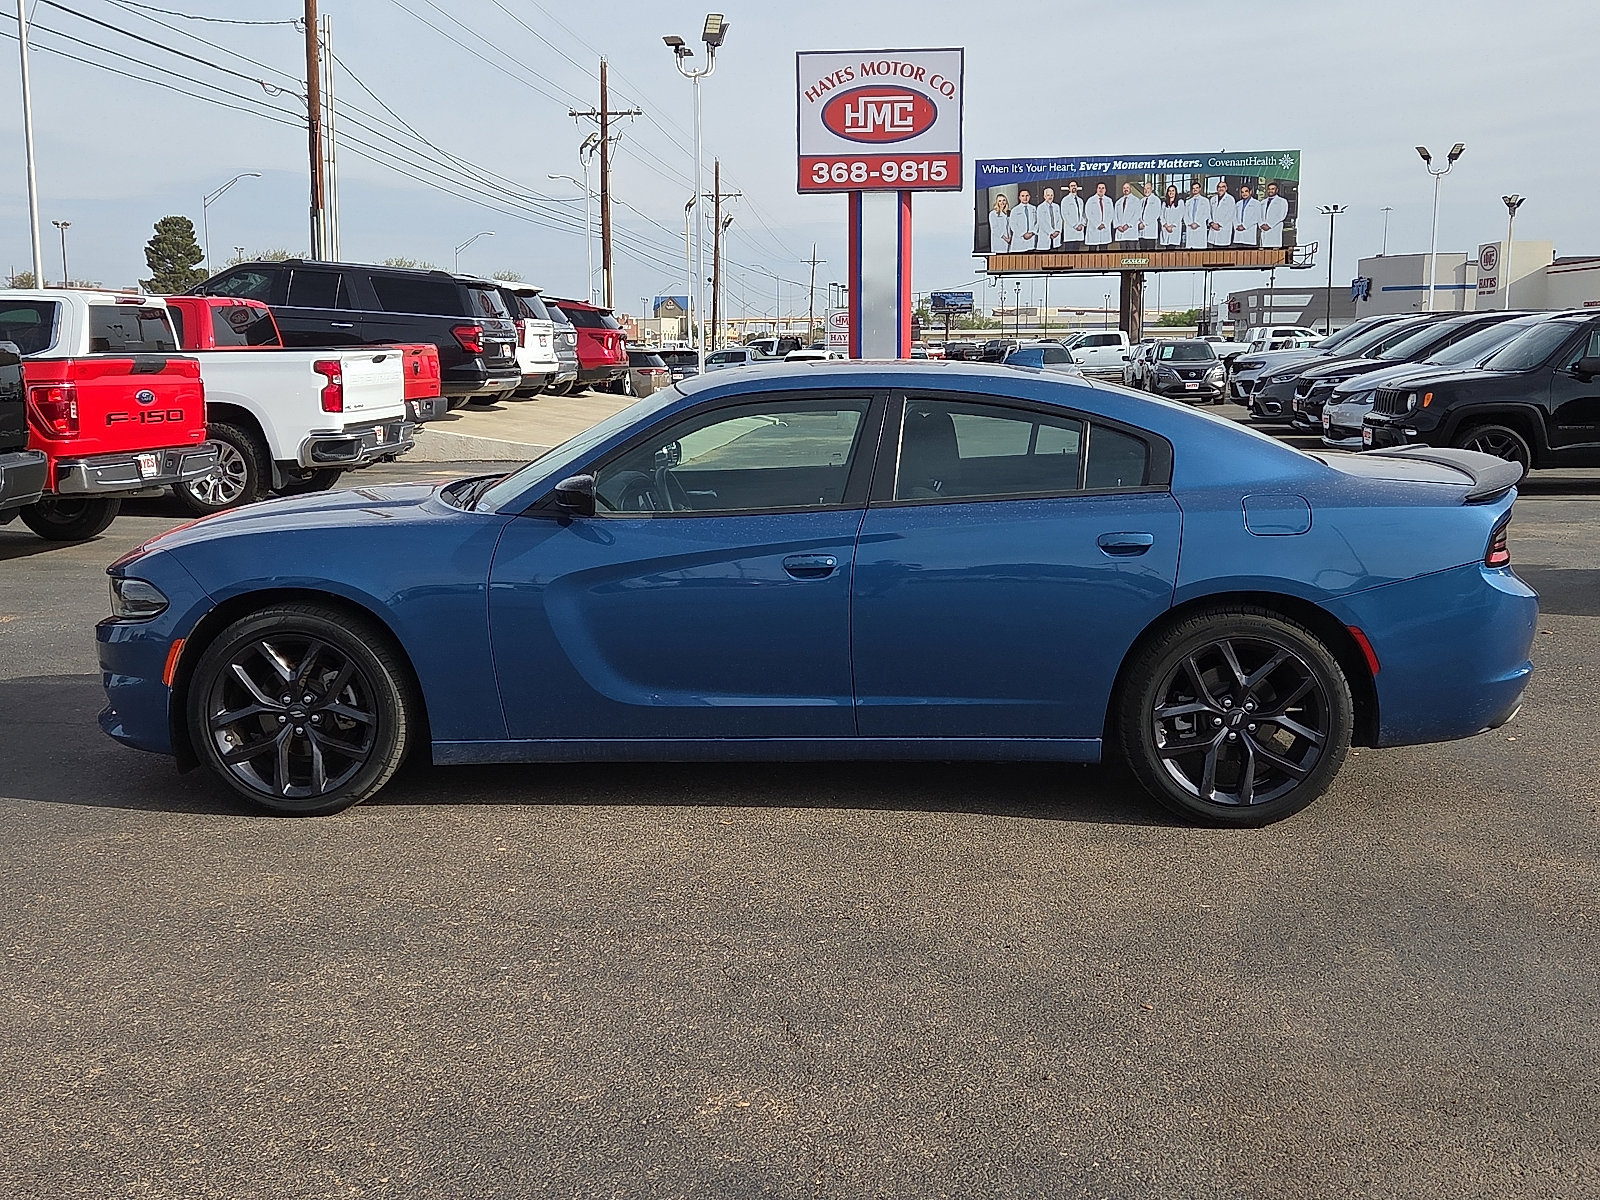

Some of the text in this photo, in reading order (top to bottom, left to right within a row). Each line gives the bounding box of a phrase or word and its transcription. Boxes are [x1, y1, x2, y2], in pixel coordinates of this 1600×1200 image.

[804, 60, 955, 103] HAYES MOTOR CO.
[844, 95, 914, 133] HMC
[982, 158, 1203, 174] When It's Your Heart, Every Moment Matters.
[1208, 155, 1277, 167] CovenantHealth
[811, 160, 948, 183] 368-9815
[105, 409, 184, 427] F-150
